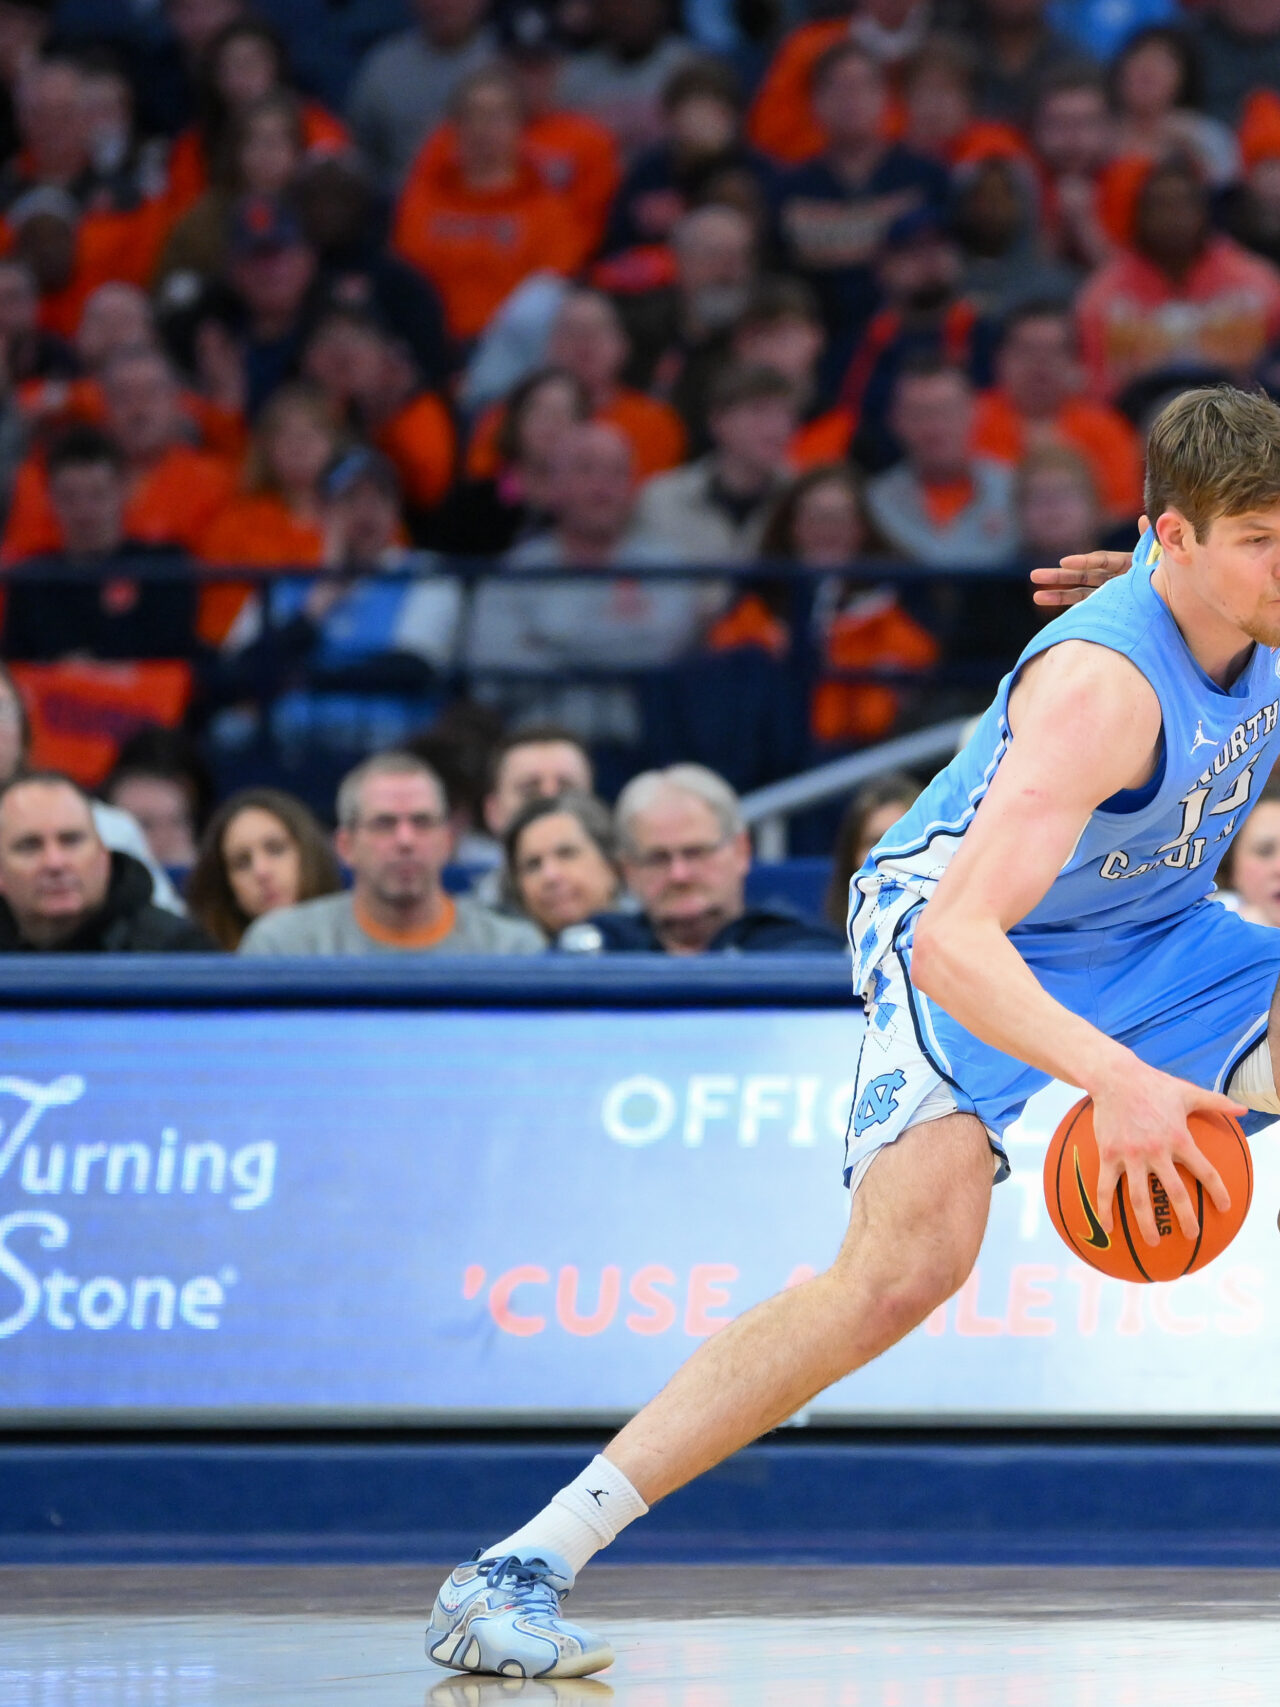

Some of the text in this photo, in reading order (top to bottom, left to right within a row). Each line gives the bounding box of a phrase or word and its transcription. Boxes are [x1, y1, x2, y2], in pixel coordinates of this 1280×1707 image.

[0, 1074, 277, 1210] Turning
[1151, 1176, 1172, 1237] SYRAC
[0, 1211, 224, 1339] Stone
[462, 1263, 739, 1337] 'CUSE
